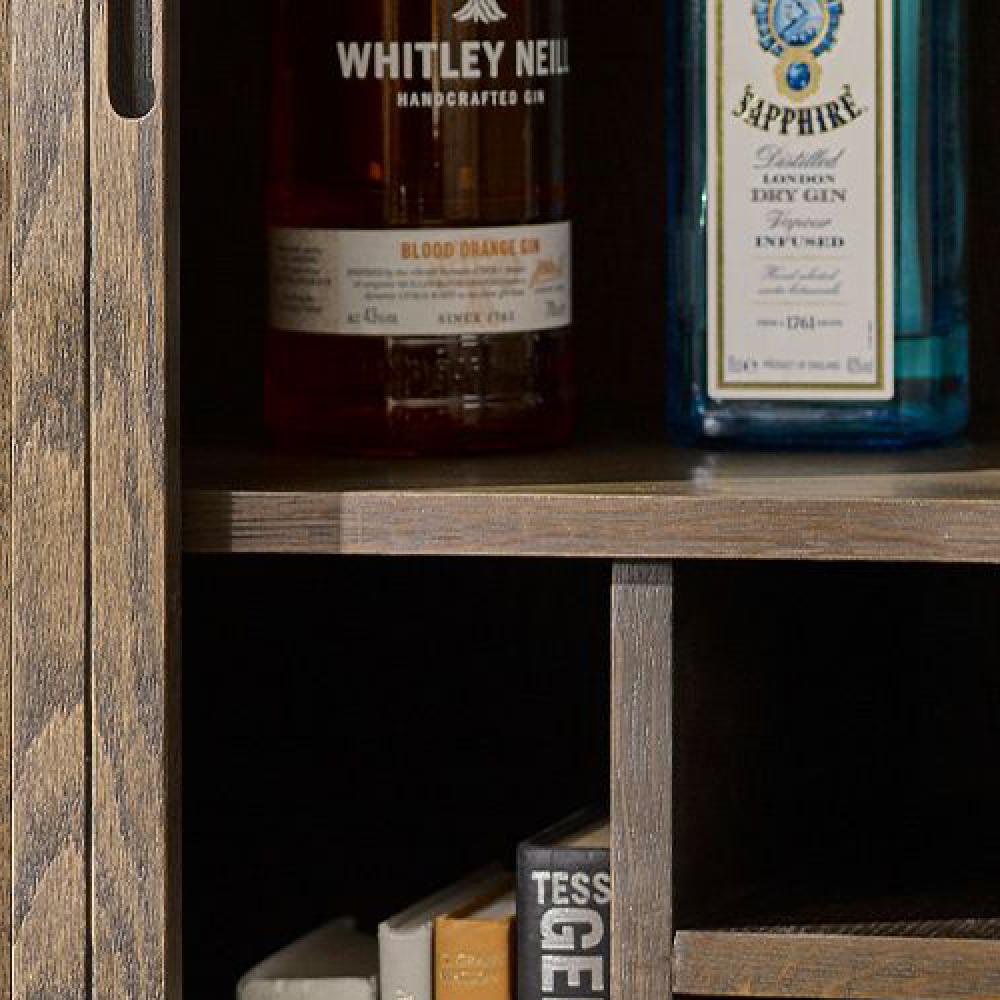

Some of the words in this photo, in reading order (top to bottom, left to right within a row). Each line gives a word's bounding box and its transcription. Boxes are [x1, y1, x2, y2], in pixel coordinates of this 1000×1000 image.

[336, 41, 505, 80] WHITLEY
[397, 90, 518, 108] HANDCRAFTED
[523, 89, 545, 105] GIN
[732, 83, 862, 136] SAPPHIRE
[762, 174, 836, 185] LONDON
[751, 187, 798, 202] DRY
[803, 187, 848, 202] GIN
[401, 240, 455, 259] BLOOD
[754, 235, 845, 248] INFUSED
[531, 871, 611, 905] TESS
